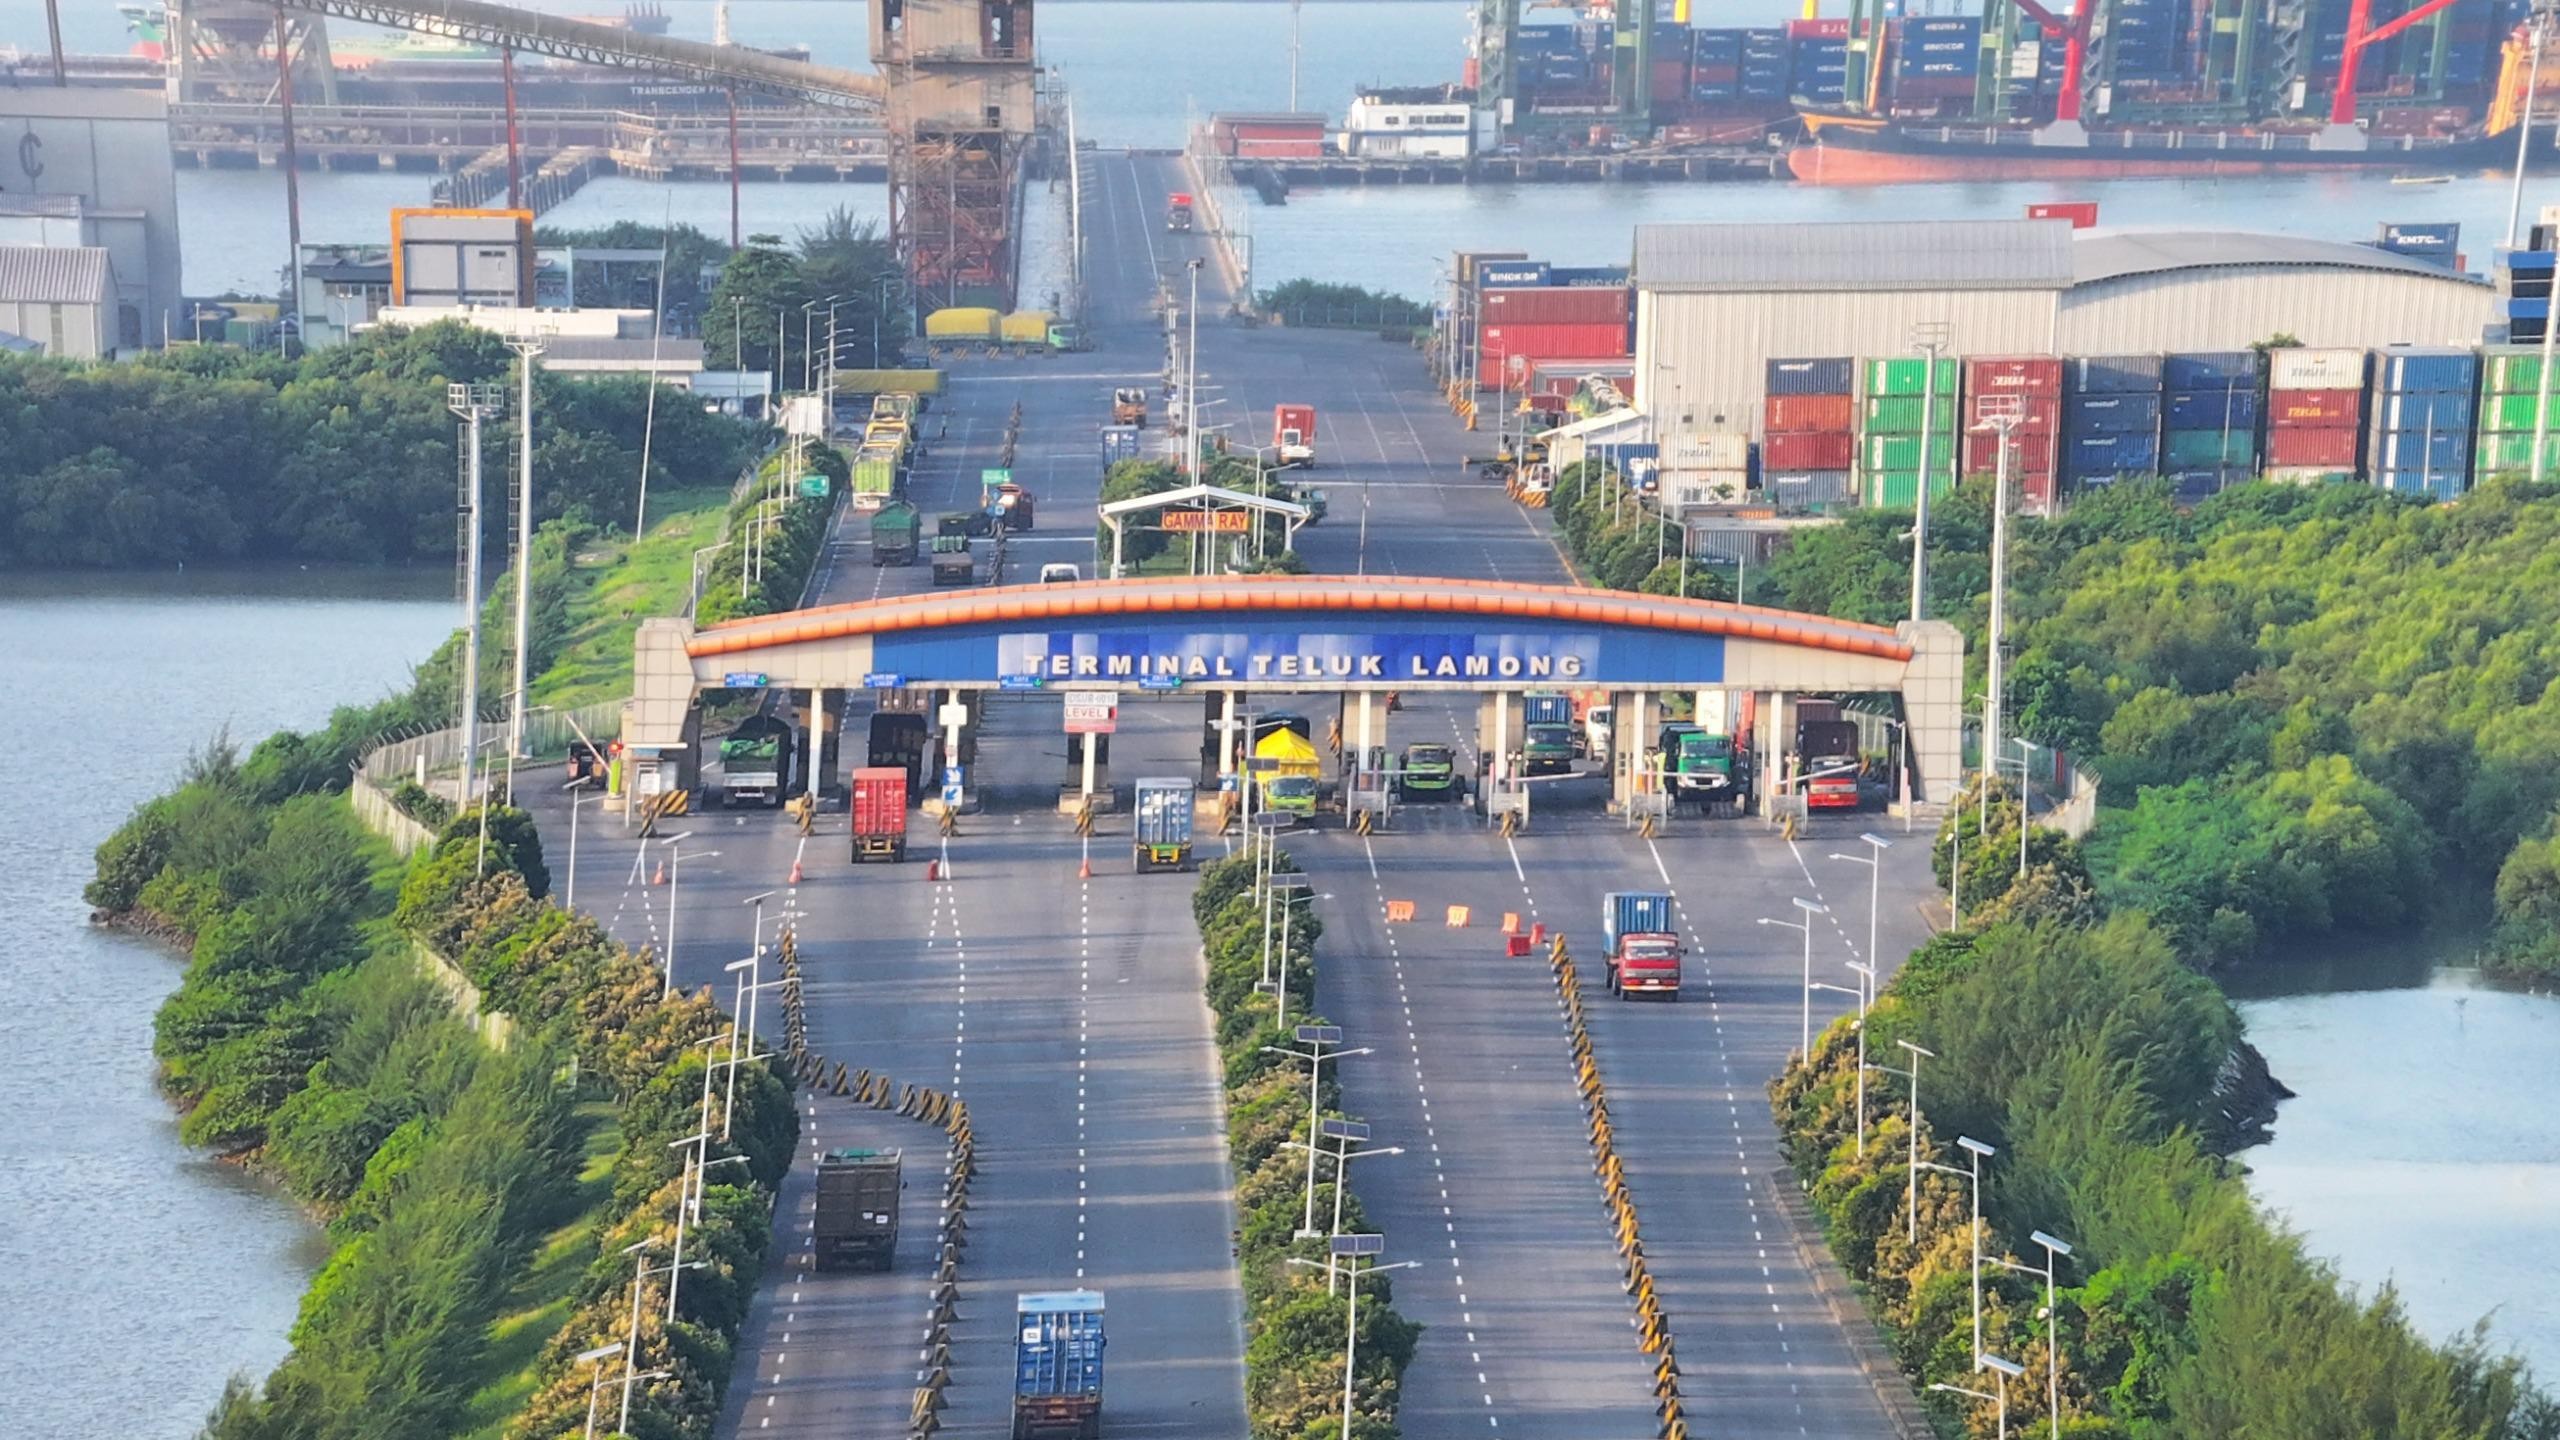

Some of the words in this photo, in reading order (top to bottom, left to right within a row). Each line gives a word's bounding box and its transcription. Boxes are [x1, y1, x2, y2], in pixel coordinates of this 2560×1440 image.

[1569, 279, 1630, 288] SINOKO
[1163, 513, 1214, 529] GAMMA
[1219, 513, 1246, 529] RAY
[1025, 655, 1233, 676] TERMINAL
[1253, 655, 1382, 675] TELUK
[1412, 655, 1581, 676] LAMONG
[1065, 707, 1103, 718] LEVEL
